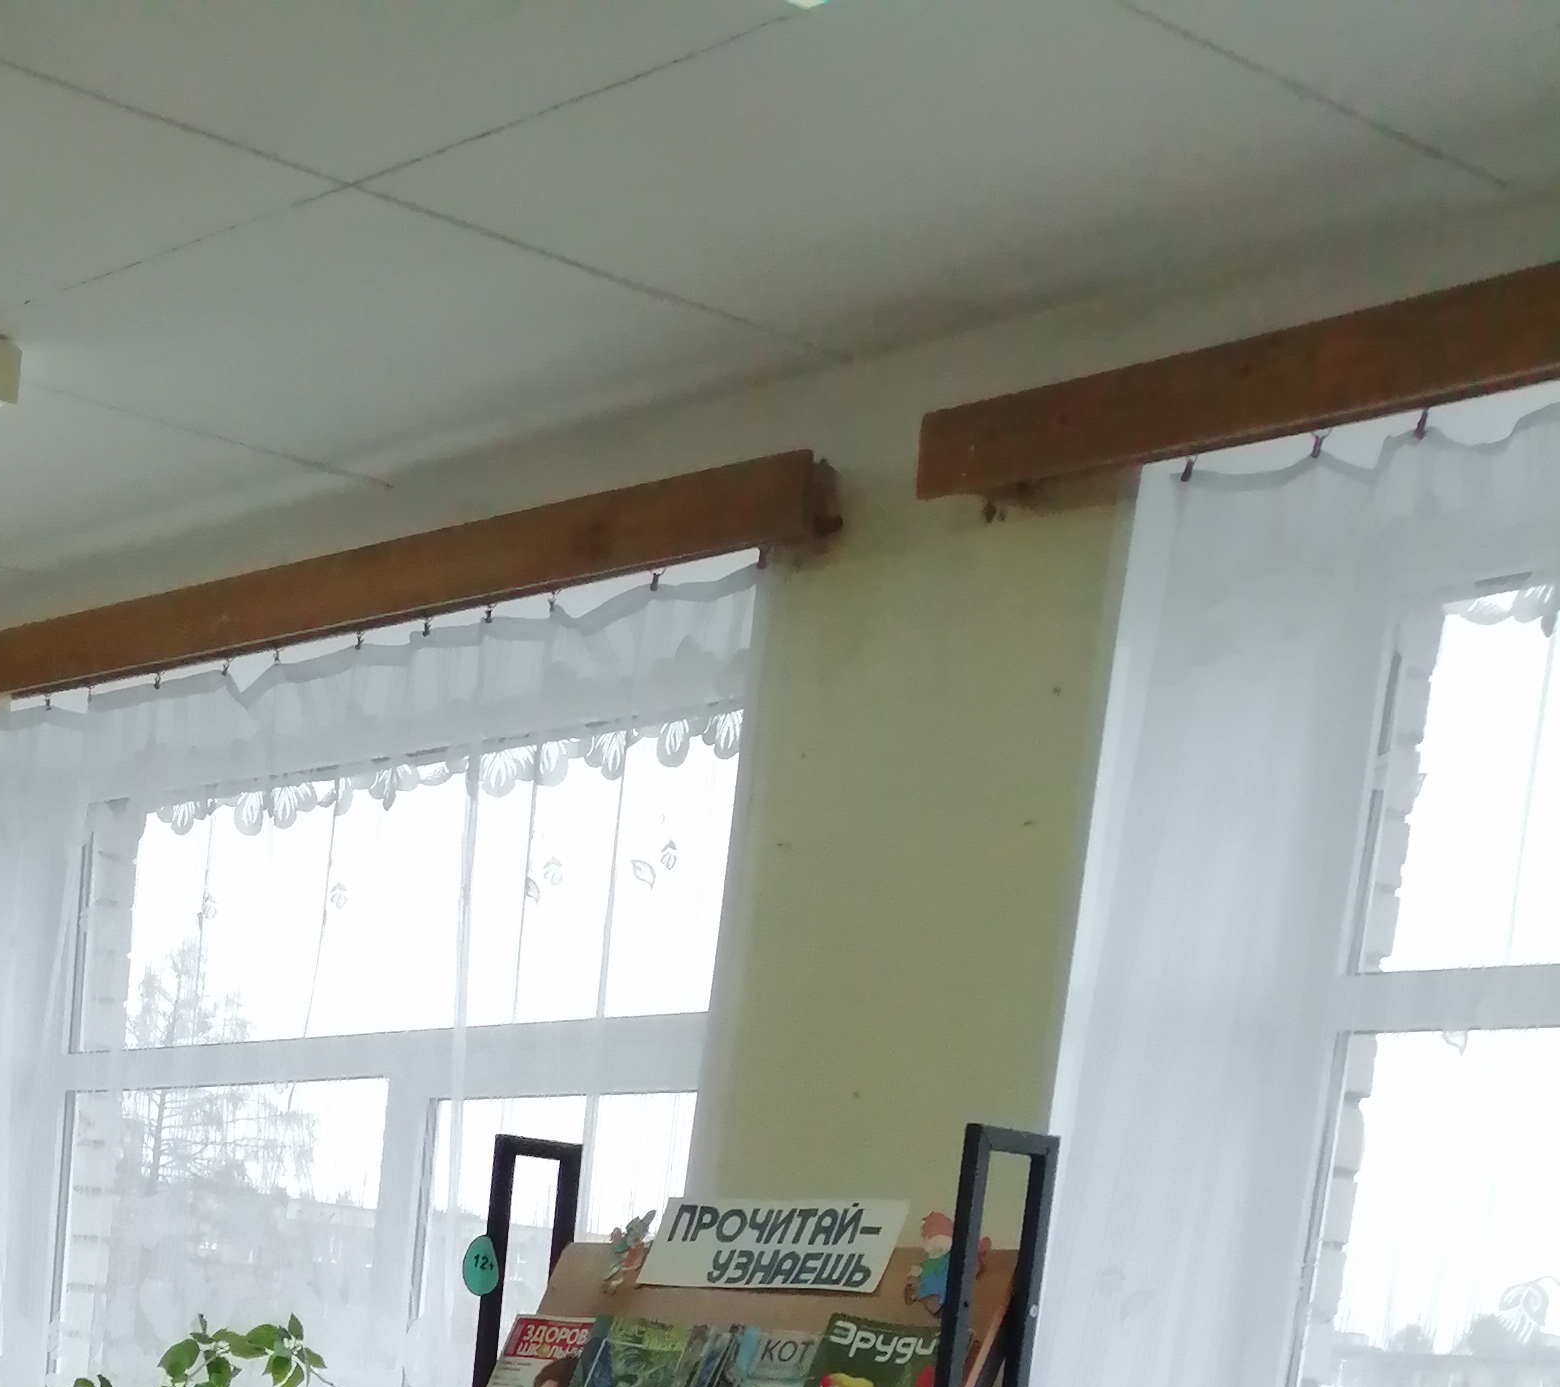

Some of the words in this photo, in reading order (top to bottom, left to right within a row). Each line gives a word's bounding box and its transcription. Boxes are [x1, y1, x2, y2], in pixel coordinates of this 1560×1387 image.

[473, 1253, 495, 1271] 12+
[706, 1250, 872, 1288] УЗНАЕШЬ
[522, 1324, 589, 1346] ЗДОРОВ
[829, 1320, 940, 1364] Эруди
[761, 1340, 815, 1363] КОТ
